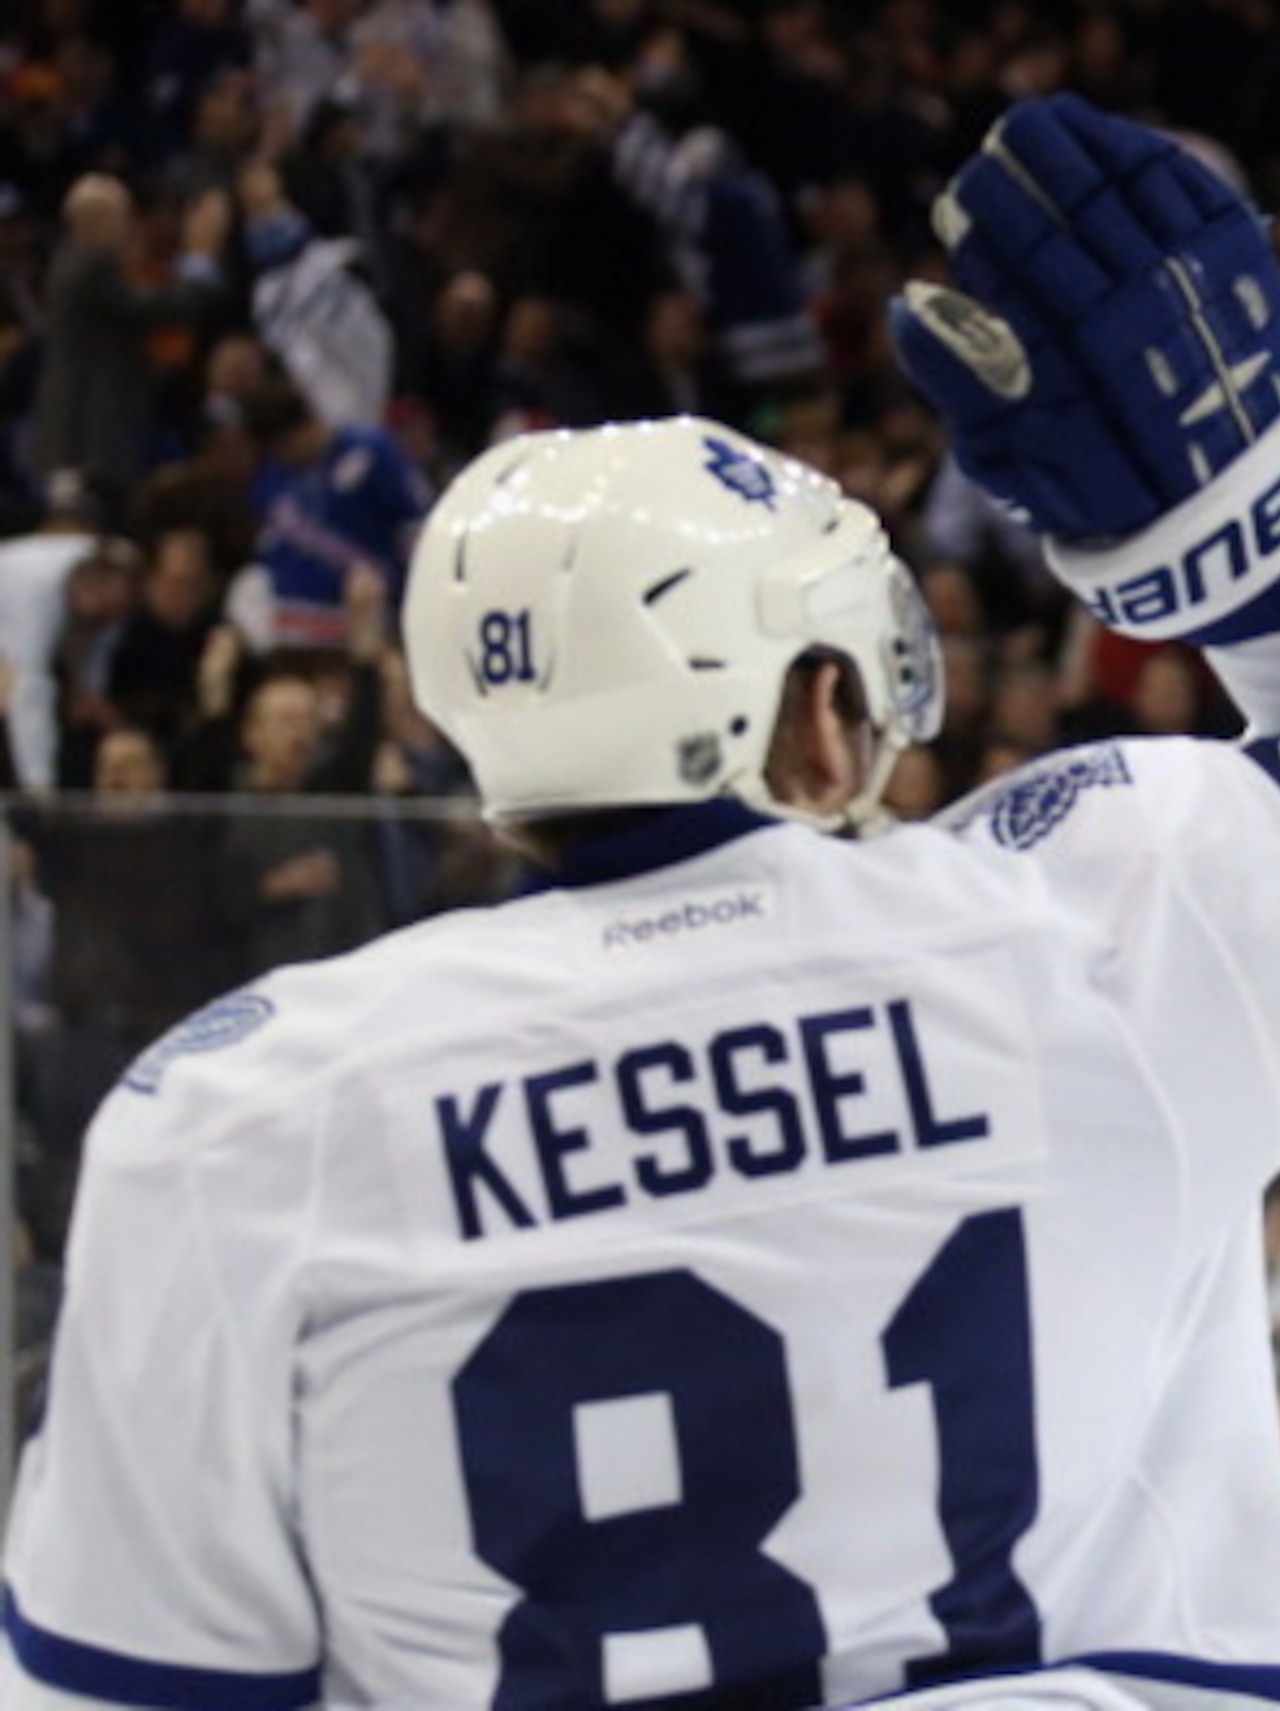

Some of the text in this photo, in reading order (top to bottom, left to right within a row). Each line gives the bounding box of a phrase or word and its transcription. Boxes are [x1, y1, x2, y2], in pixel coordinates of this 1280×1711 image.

[479, 606, 536, 684] 81
[601, 889, 766, 950] Reebok
[434, 999, 990, 1241] KESSEL
[451, 1206, 1044, 1711] 81
